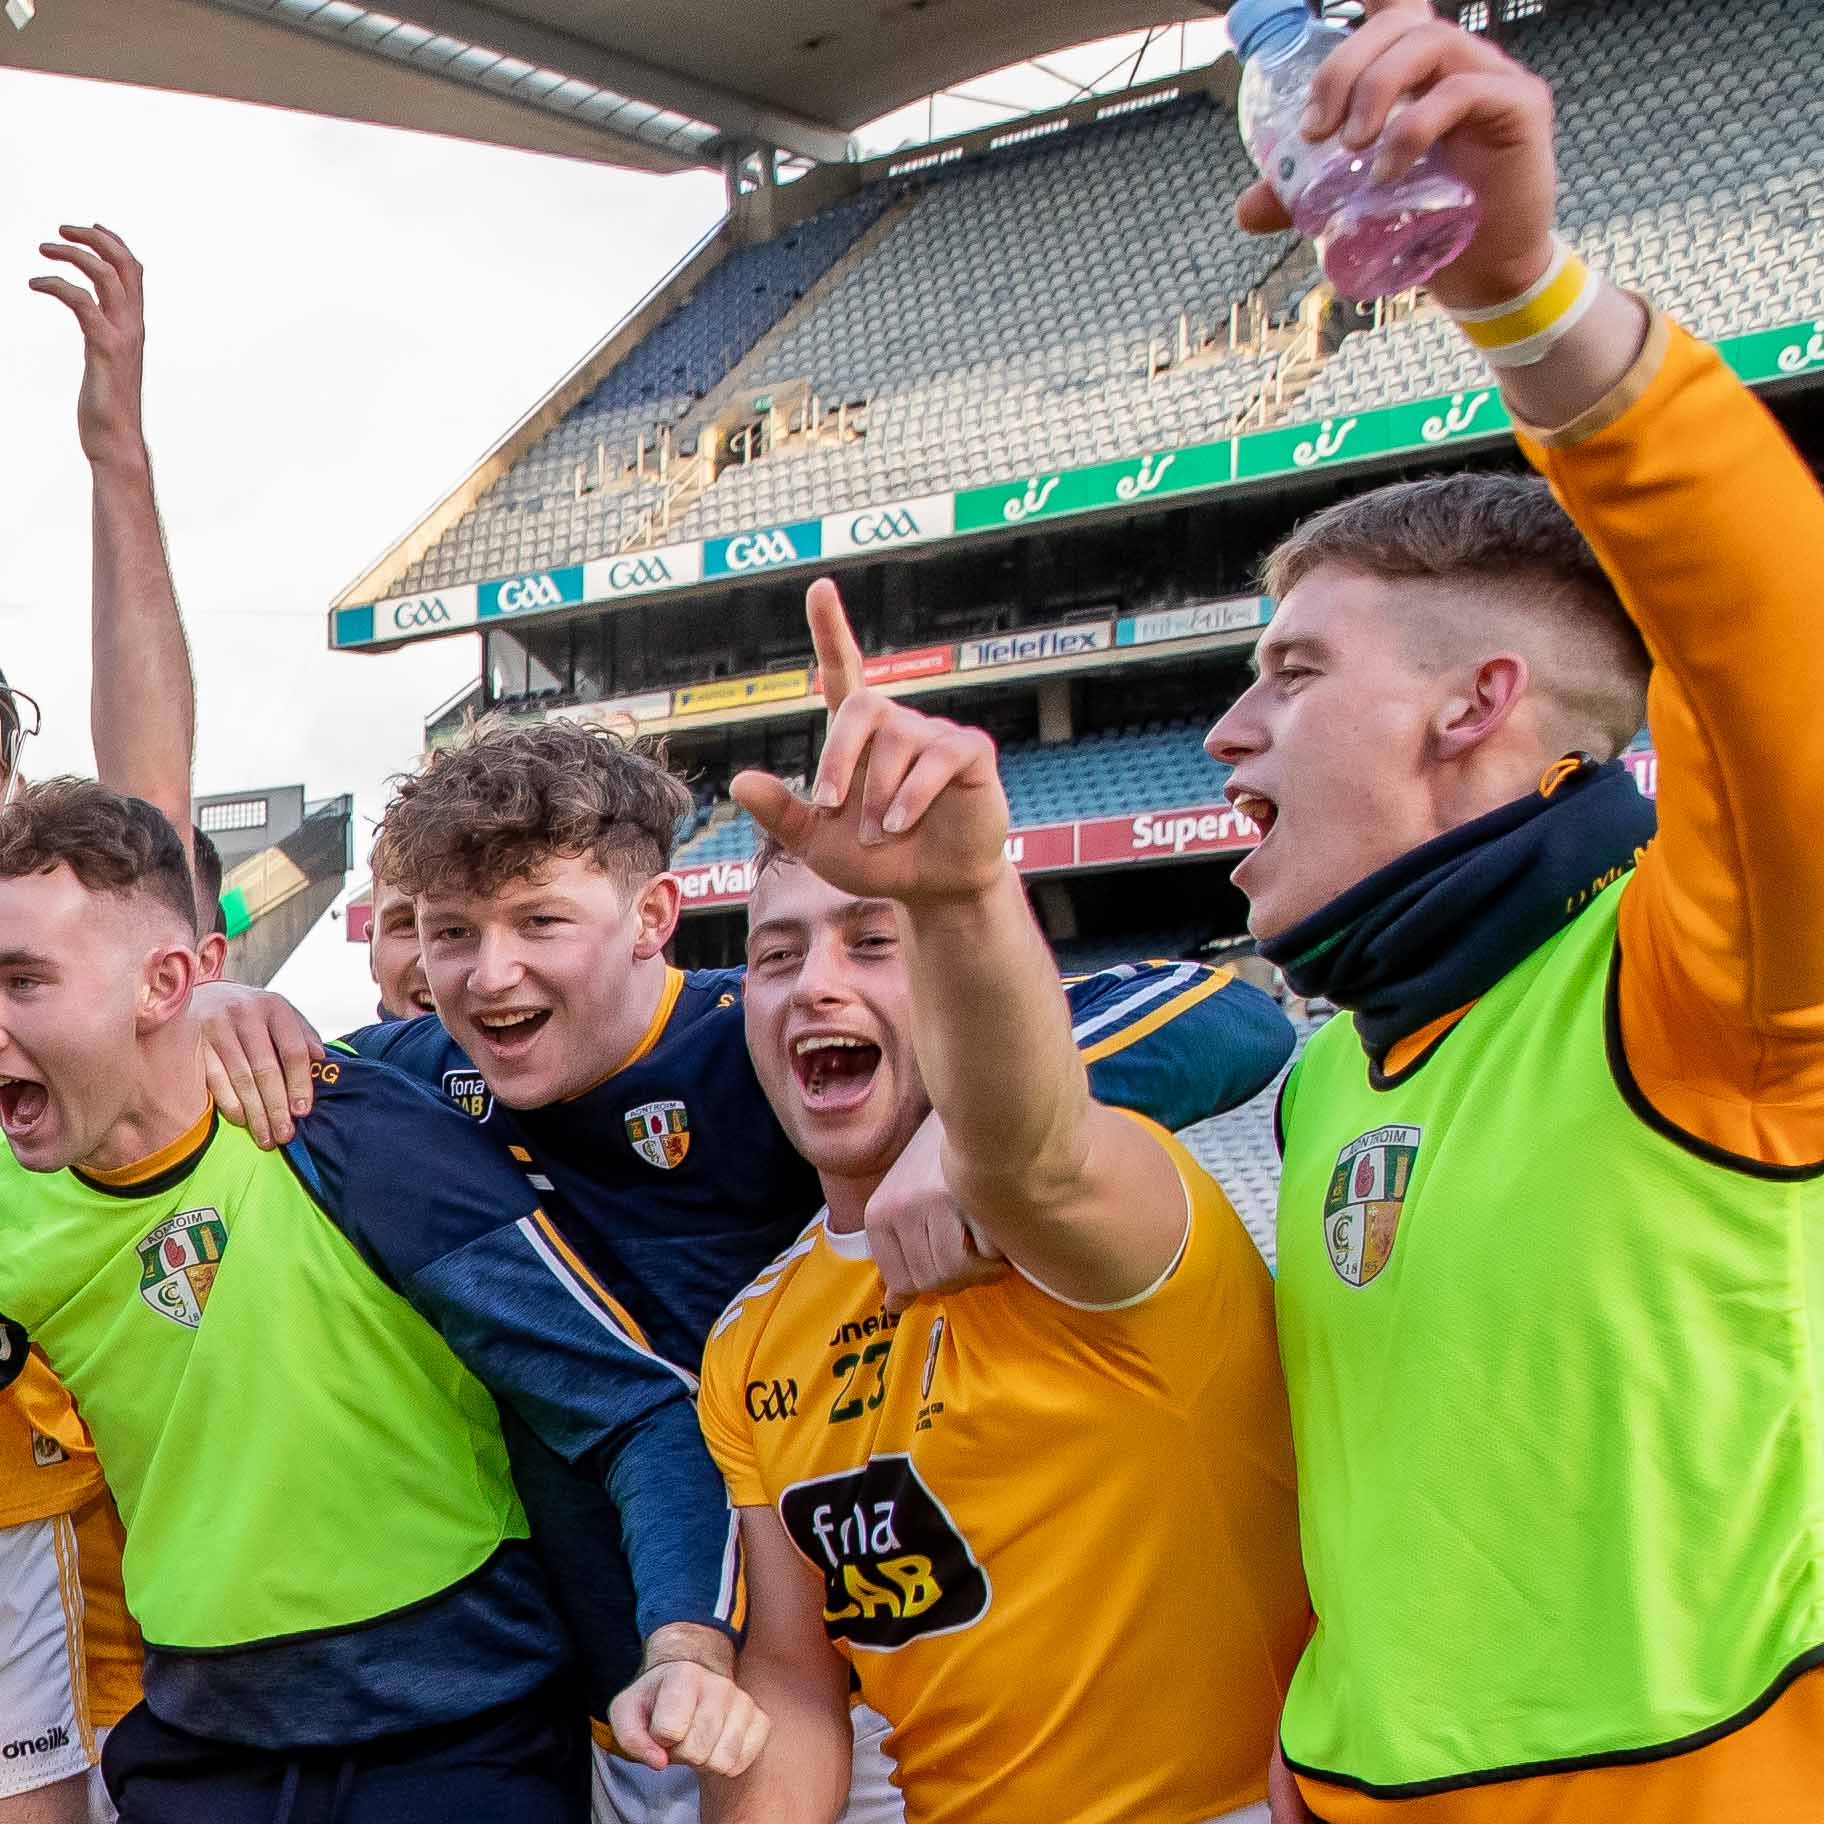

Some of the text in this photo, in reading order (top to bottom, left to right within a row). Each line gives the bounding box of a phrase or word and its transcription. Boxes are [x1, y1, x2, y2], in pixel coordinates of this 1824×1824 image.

[1776, 320, 1824, 372] ei
[1421, 391, 1489, 442] eir
[1292, 418, 1357, 467] eir
[1003, 475, 1059, 521] eir
[1115, 453, 1174, 500] eir
[977, 628, 1098, 666] Teleflex
[1132, 810, 1258, 853] SuperV
[450, 1076, 486, 1097] fona
[453, 1095, 484, 1116] AB
[828, 1337, 895, 1424] 23
